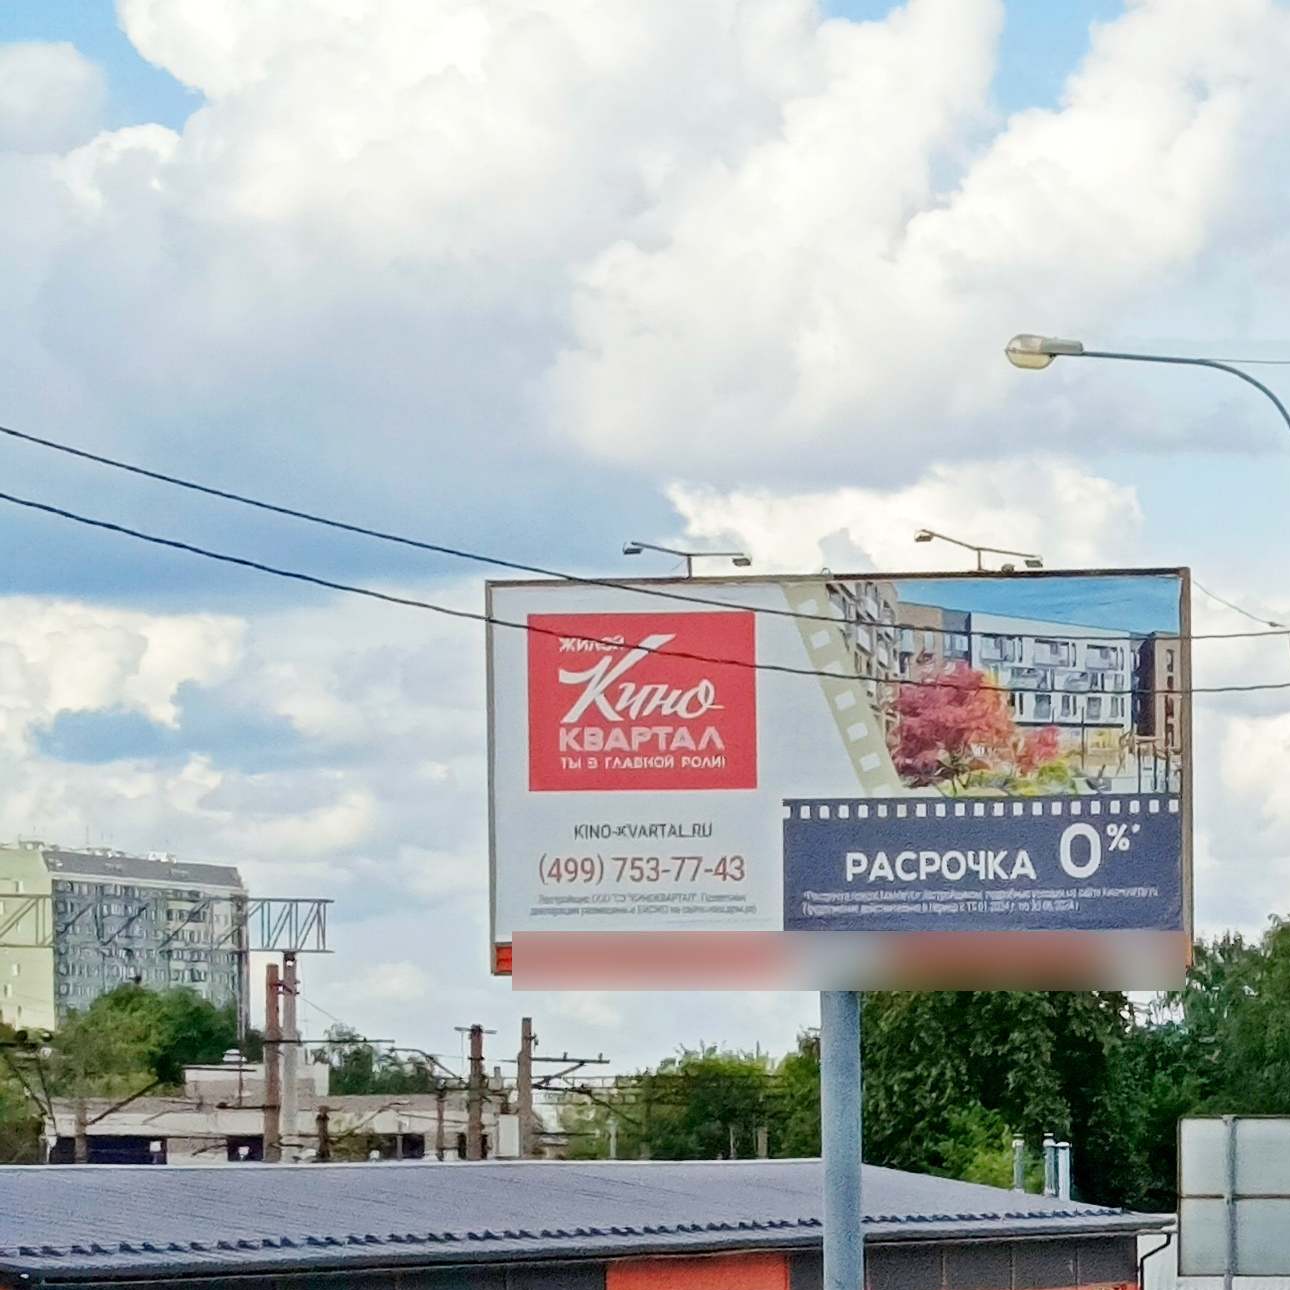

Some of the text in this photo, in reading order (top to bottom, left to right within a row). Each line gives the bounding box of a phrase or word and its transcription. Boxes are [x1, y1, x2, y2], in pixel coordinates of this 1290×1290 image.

[559, 726, 725, 752] КВАРТАЛ
[561, 756, 582, 769] ТЫ
[605, 755, 674, 769] ГЛАВНОЙ
[538, 852, 746, 885] (499) 753-77-43
[845, 850, 1037, 881] РАСРОЧКА
